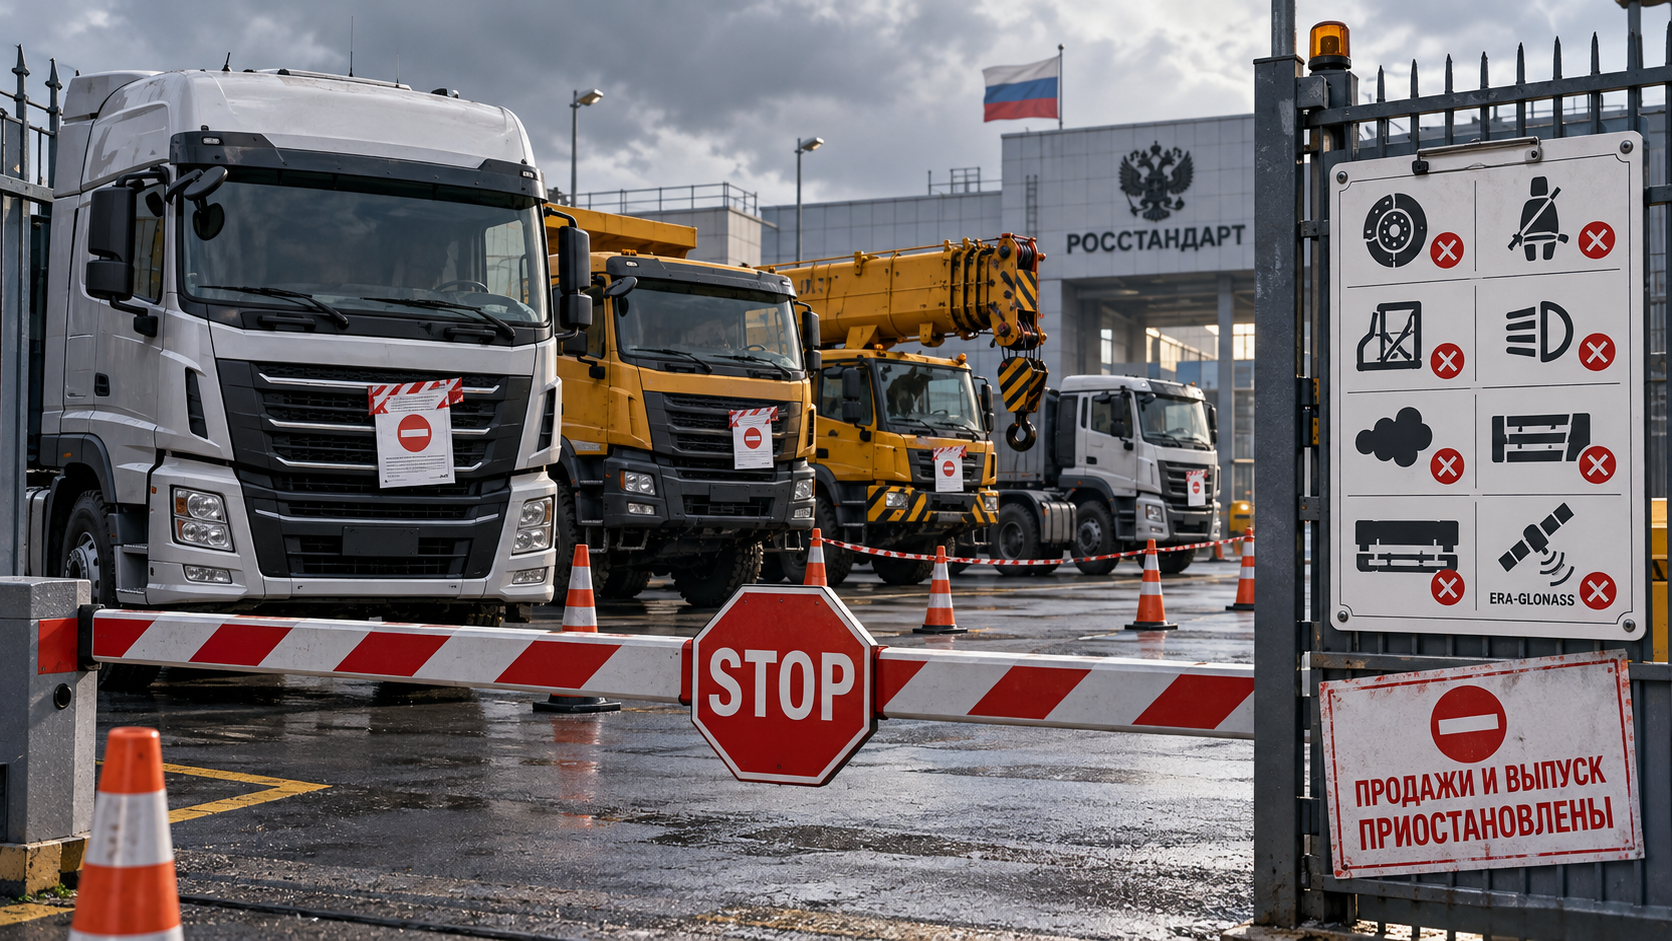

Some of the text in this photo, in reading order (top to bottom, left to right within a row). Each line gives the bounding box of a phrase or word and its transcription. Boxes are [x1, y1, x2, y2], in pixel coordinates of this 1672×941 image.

[1067, 224, 1246, 254] РОССТАНДАРТ
[1489, 592, 1575, 606] ERA-GLONASS
[708, 647, 856, 721] STOP
[1355, 755, 1607, 808] ПРОДАЖИ И ВЫПУСК
[1358, 796, 1615, 851] ПРИОСТАНОВЛЕНЫ
